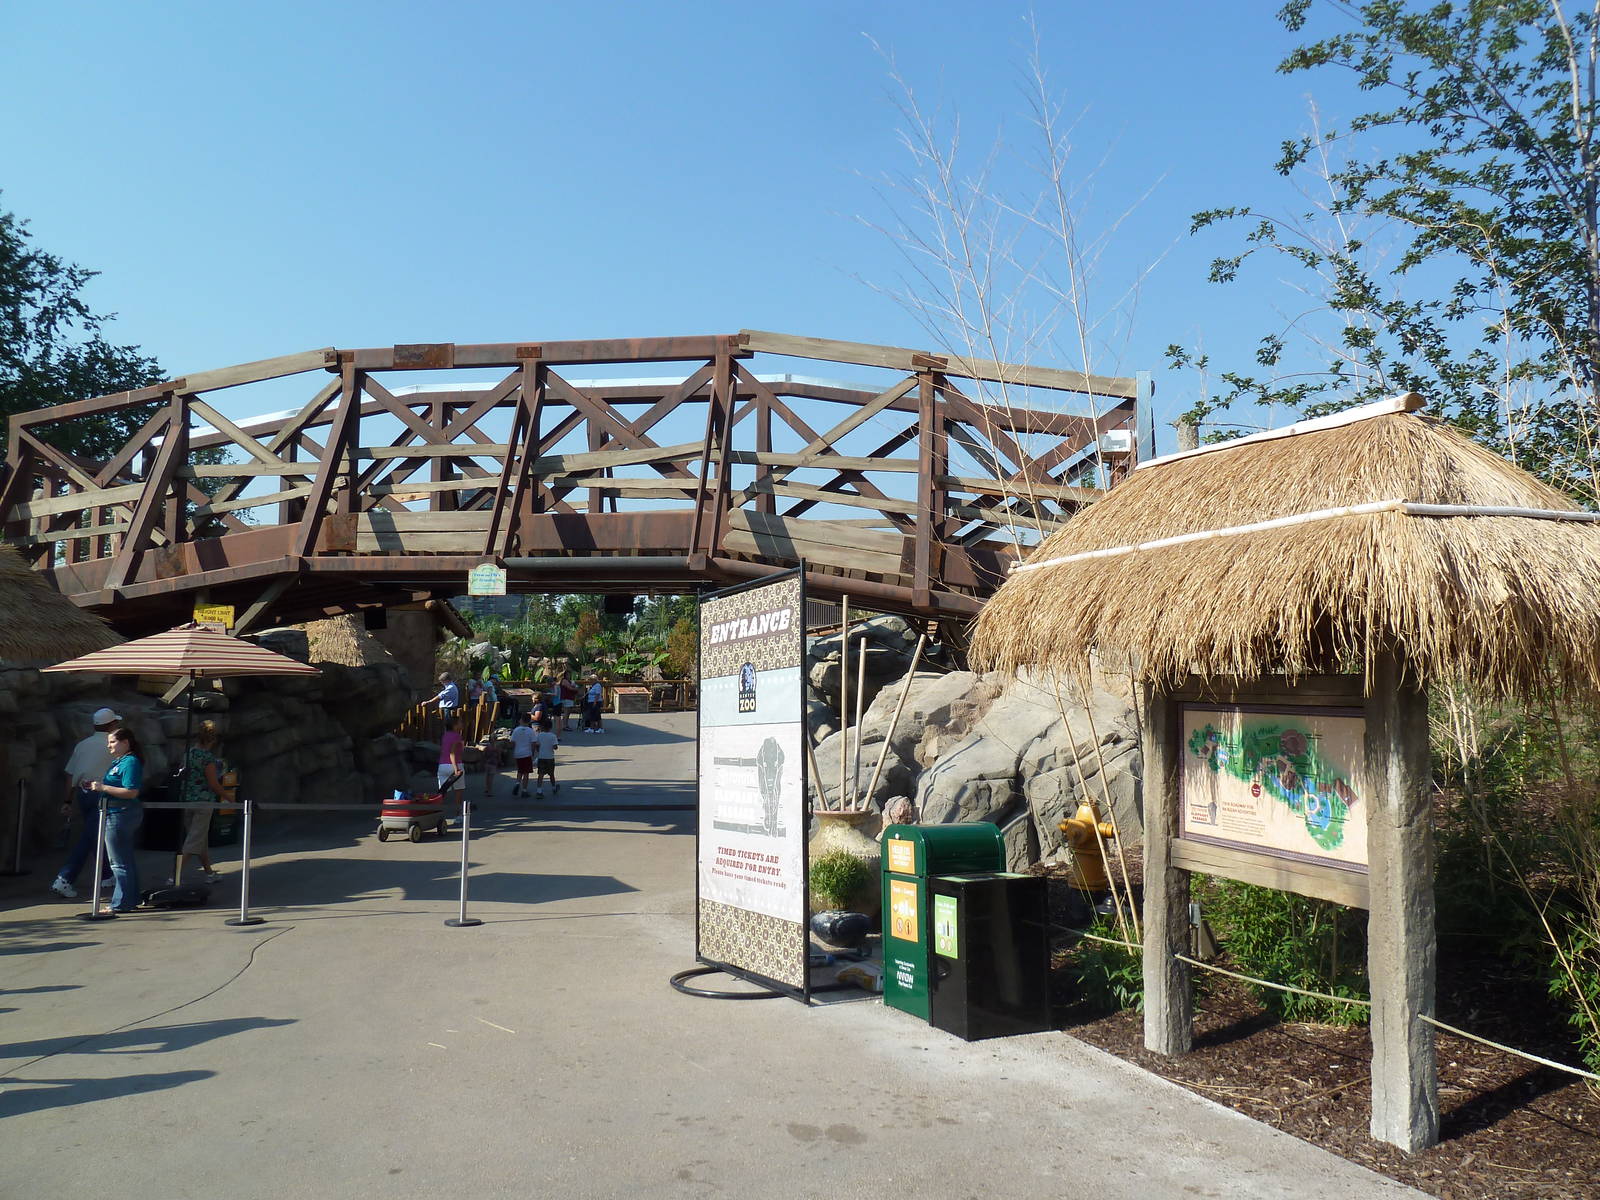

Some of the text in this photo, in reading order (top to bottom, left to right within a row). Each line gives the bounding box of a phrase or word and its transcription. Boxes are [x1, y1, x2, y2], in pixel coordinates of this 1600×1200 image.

[710, 608, 791, 645] ENTRANCE
[740, 698, 756, 711] ZOO
[716, 857, 744, 870] REQUIRED
[745, 862, 757, 871] FOR
[718, 846, 780, 864] TIMED TICKETS ARE
[711, 867, 724, 876] Please
[734, 872, 743, 880] your
[744, 873, 756, 882] timed
[757, 876, 773, 886] tickets
